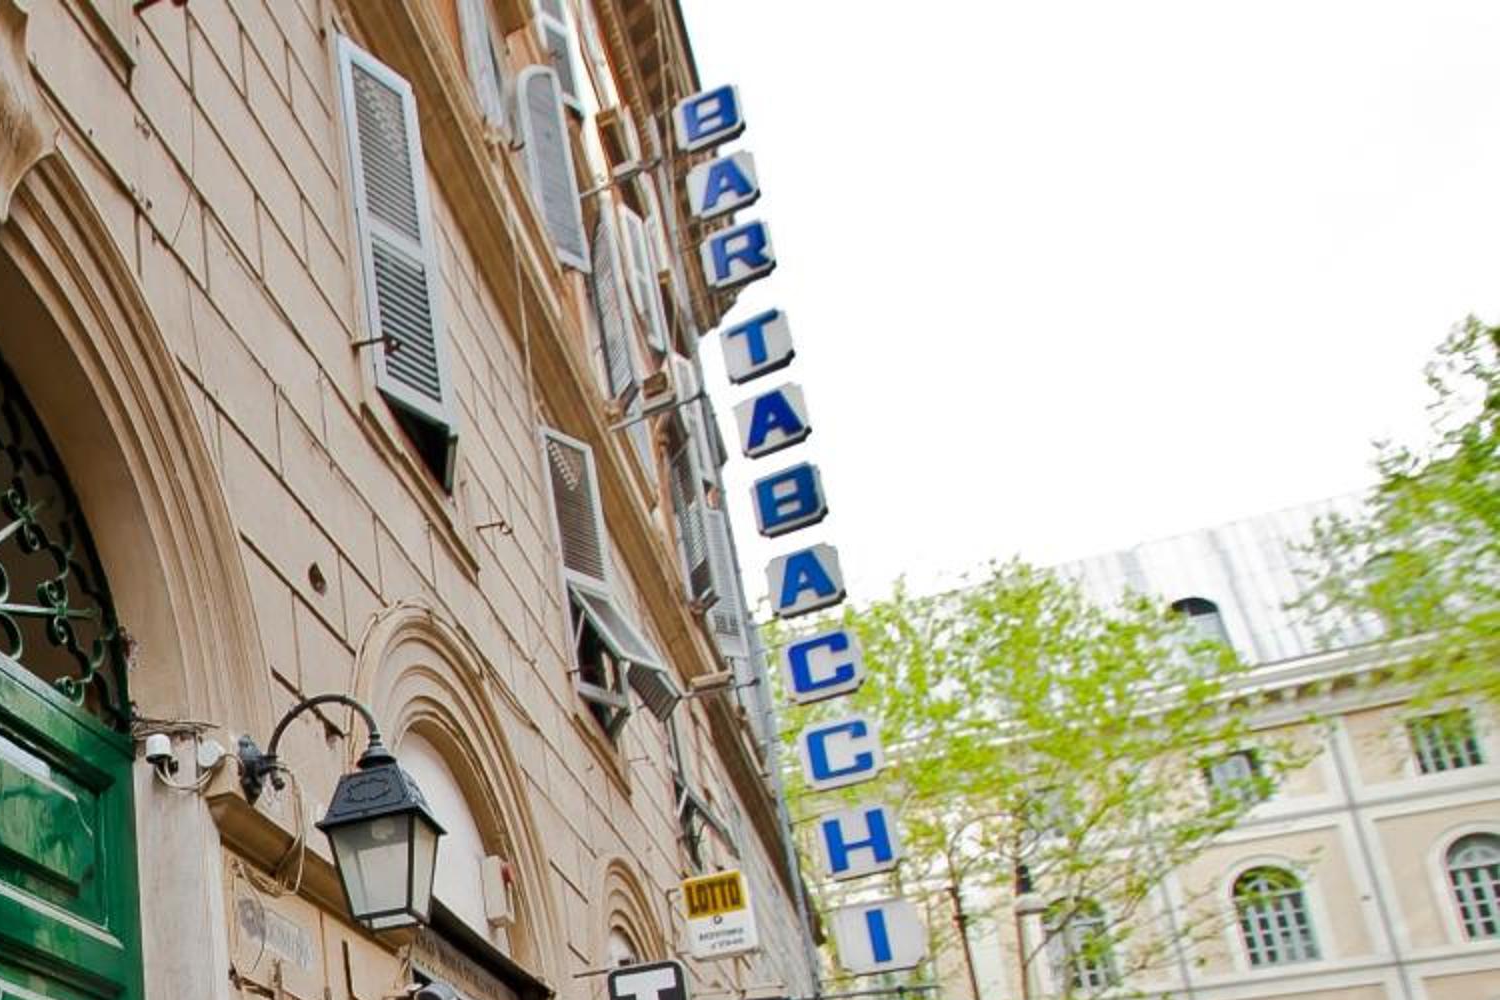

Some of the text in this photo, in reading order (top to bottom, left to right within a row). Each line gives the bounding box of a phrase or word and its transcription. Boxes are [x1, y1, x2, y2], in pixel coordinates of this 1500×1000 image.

[682, 83, 894, 962] BAR TABACCHI
[685, 878, 741, 915] LOTTO
